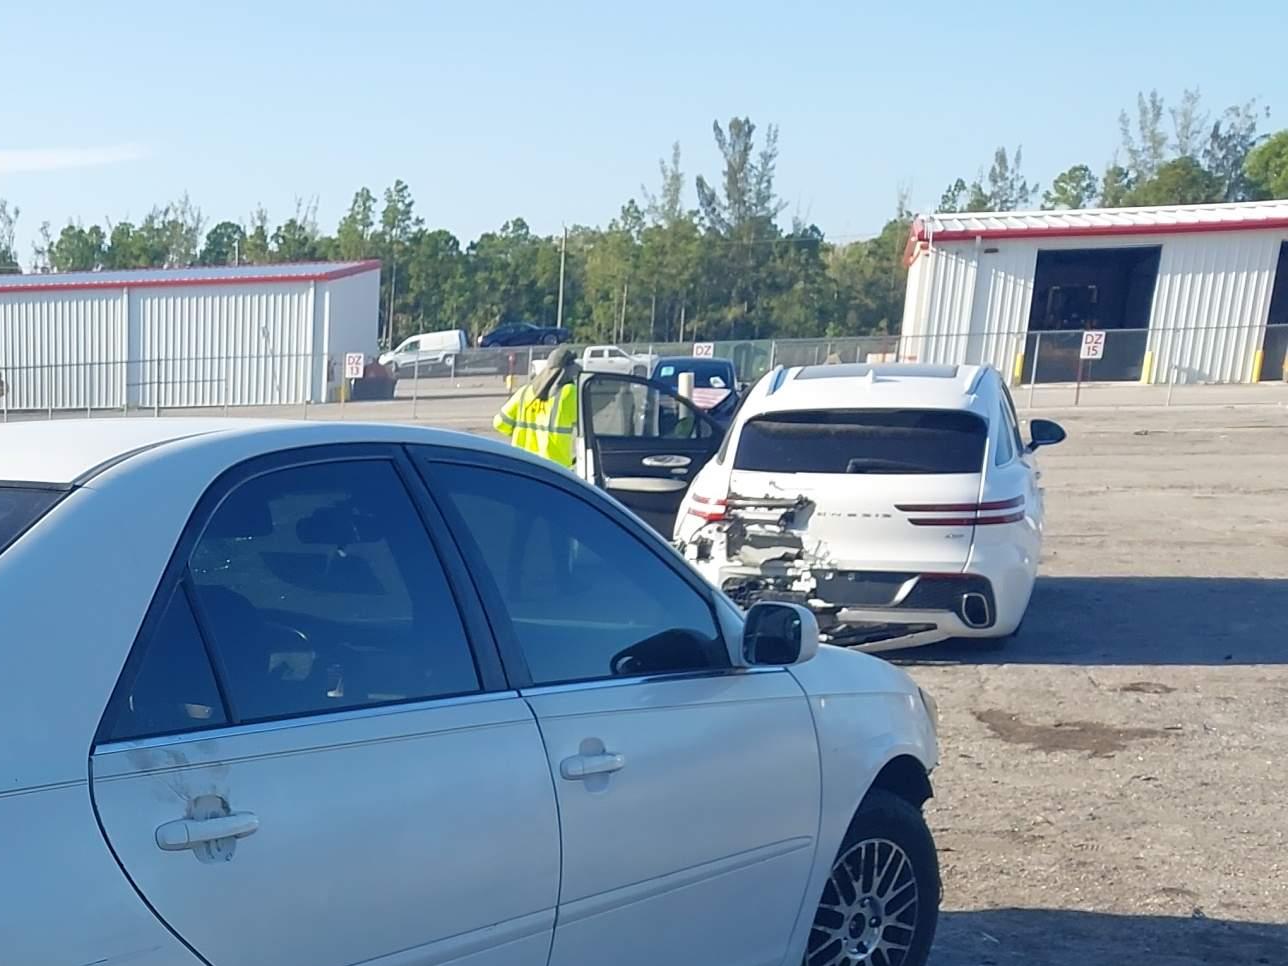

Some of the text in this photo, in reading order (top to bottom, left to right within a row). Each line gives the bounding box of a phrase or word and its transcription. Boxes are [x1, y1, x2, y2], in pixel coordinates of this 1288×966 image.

[1085, 333, 1103, 345] DZ
[695, 345, 712, 356] DZ
[1087, 345, 1098, 356] 15
[347, 355, 362, 366] DZ
